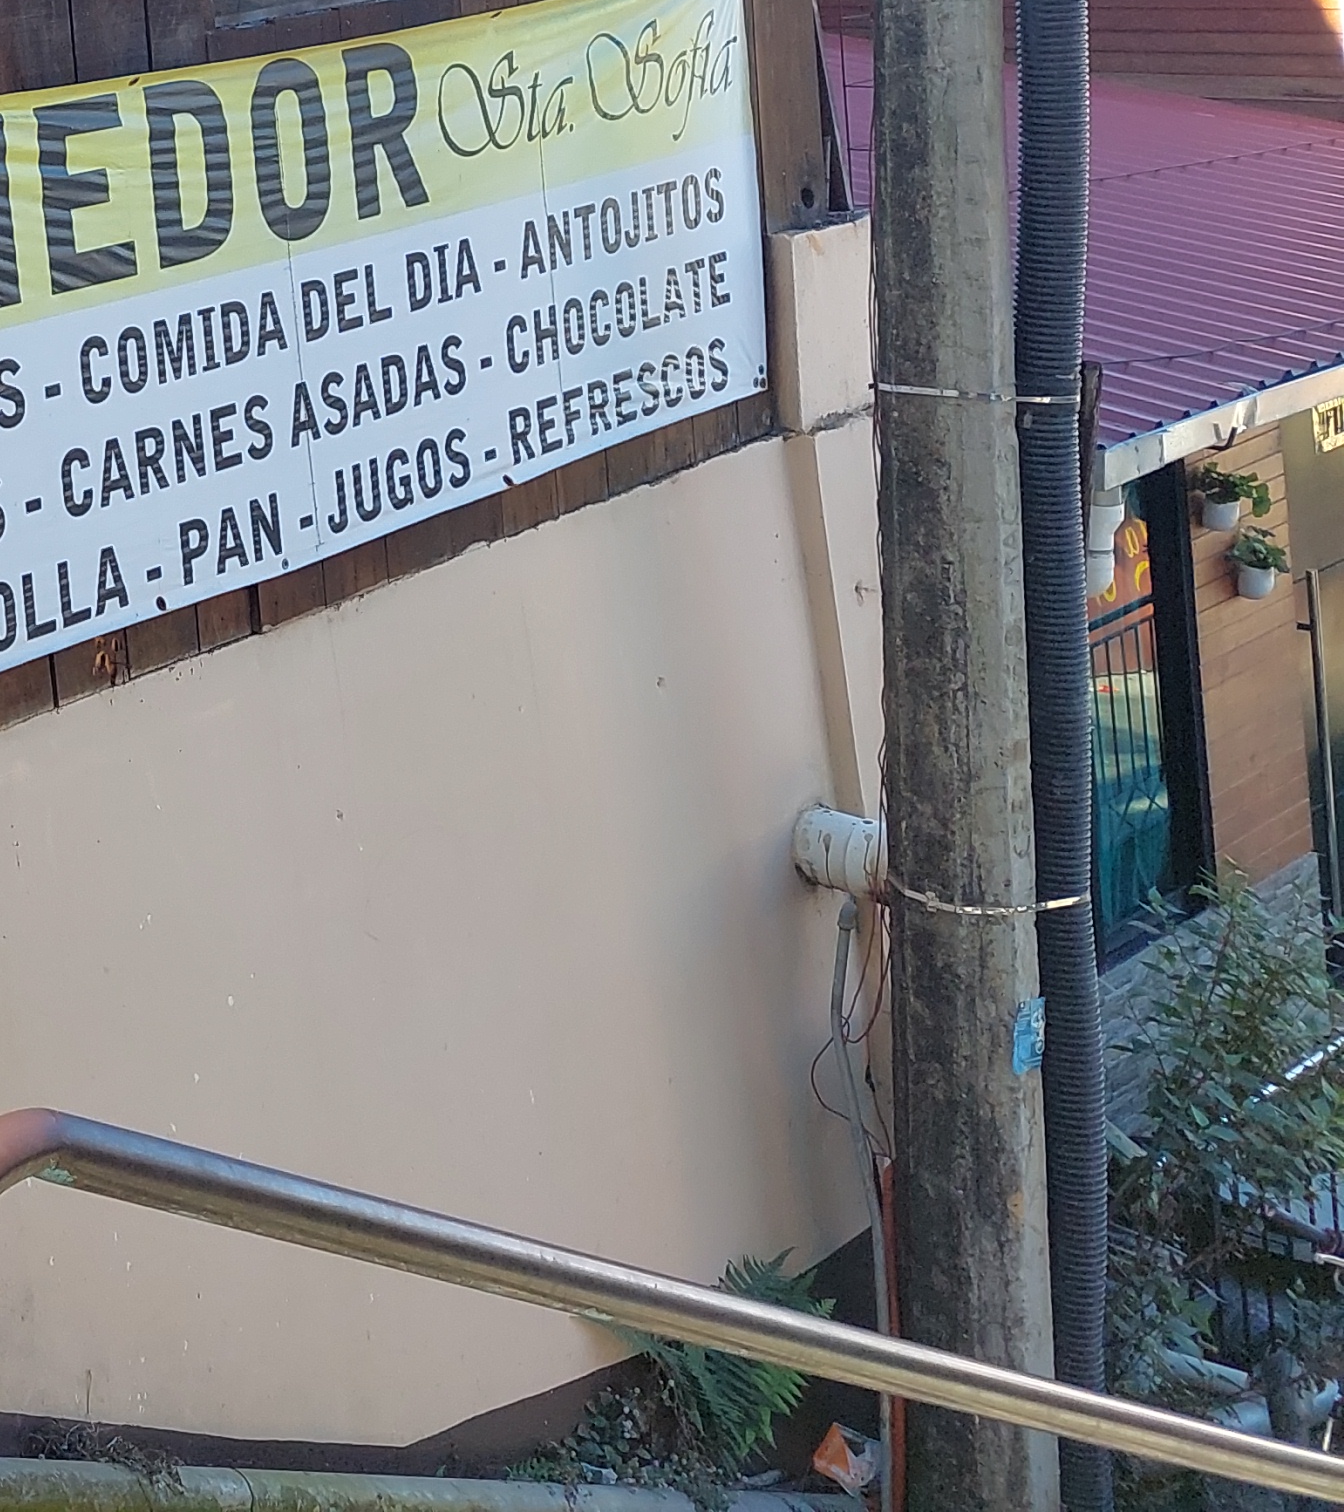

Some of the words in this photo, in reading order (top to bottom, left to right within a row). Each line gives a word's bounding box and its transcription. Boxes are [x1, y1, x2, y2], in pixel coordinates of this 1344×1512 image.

[61, 394, 274, 517] CARNES
[291, 335, 466, 448] ASADAS
[506, 251, 731, 374] CHOCOLATE
[79, 292, 287, 405] COMIDA
[302, 263, 392, 342] DEL
[406, 238, 481, 313] DIA
[519, 167, 725, 279] ANTOJITOS
[179, 492, 282, 586] PAN
[327, 428, 471, 535] JUGOS
[507, 337, 730, 467] REFRESCOS
